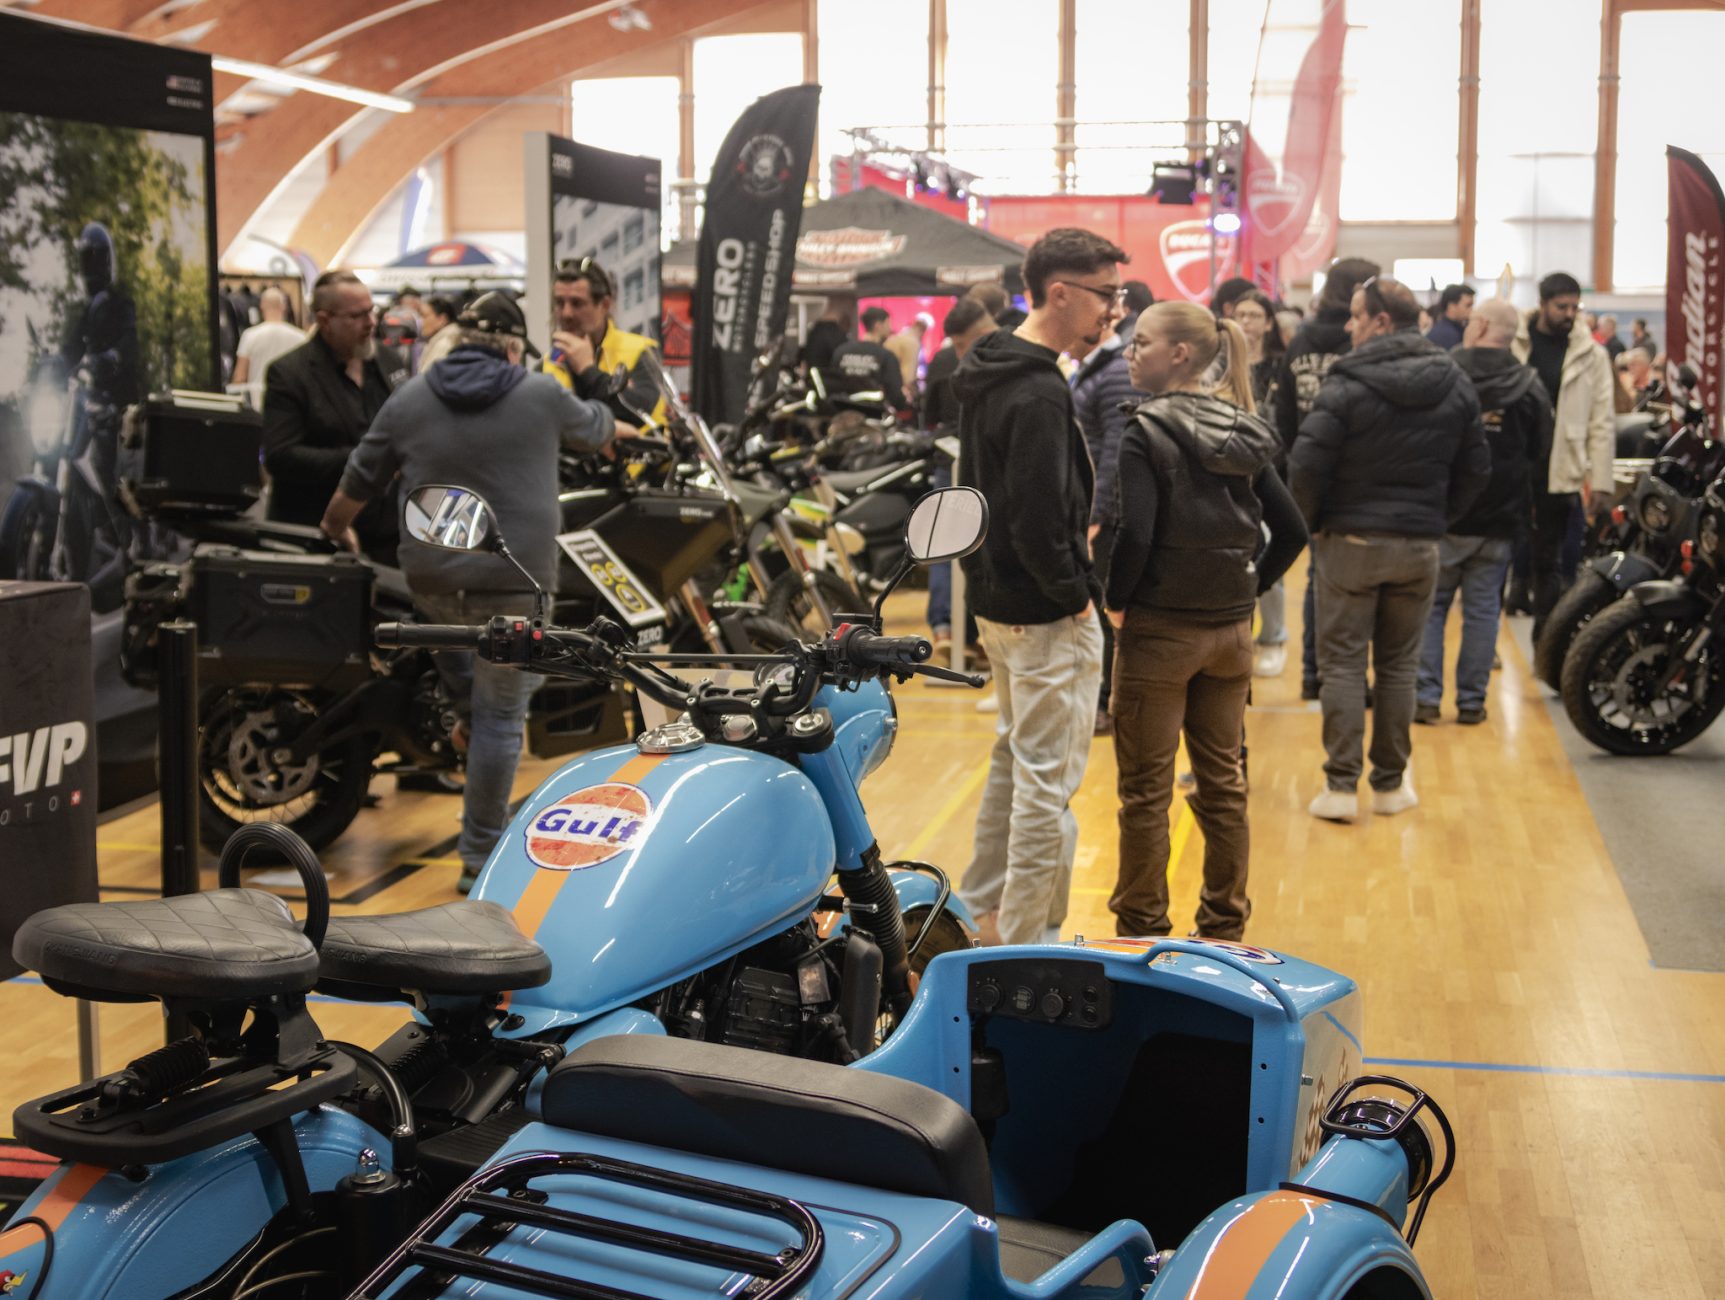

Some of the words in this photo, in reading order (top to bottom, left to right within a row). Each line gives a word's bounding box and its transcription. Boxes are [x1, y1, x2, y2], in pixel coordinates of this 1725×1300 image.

[712, 238, 745, 351] ZERO
[754, 208, 785, 349] SPEEDSHOP
[637, 625, 662, 645] ZERO
[535, 808, 642, 843] Gulf
